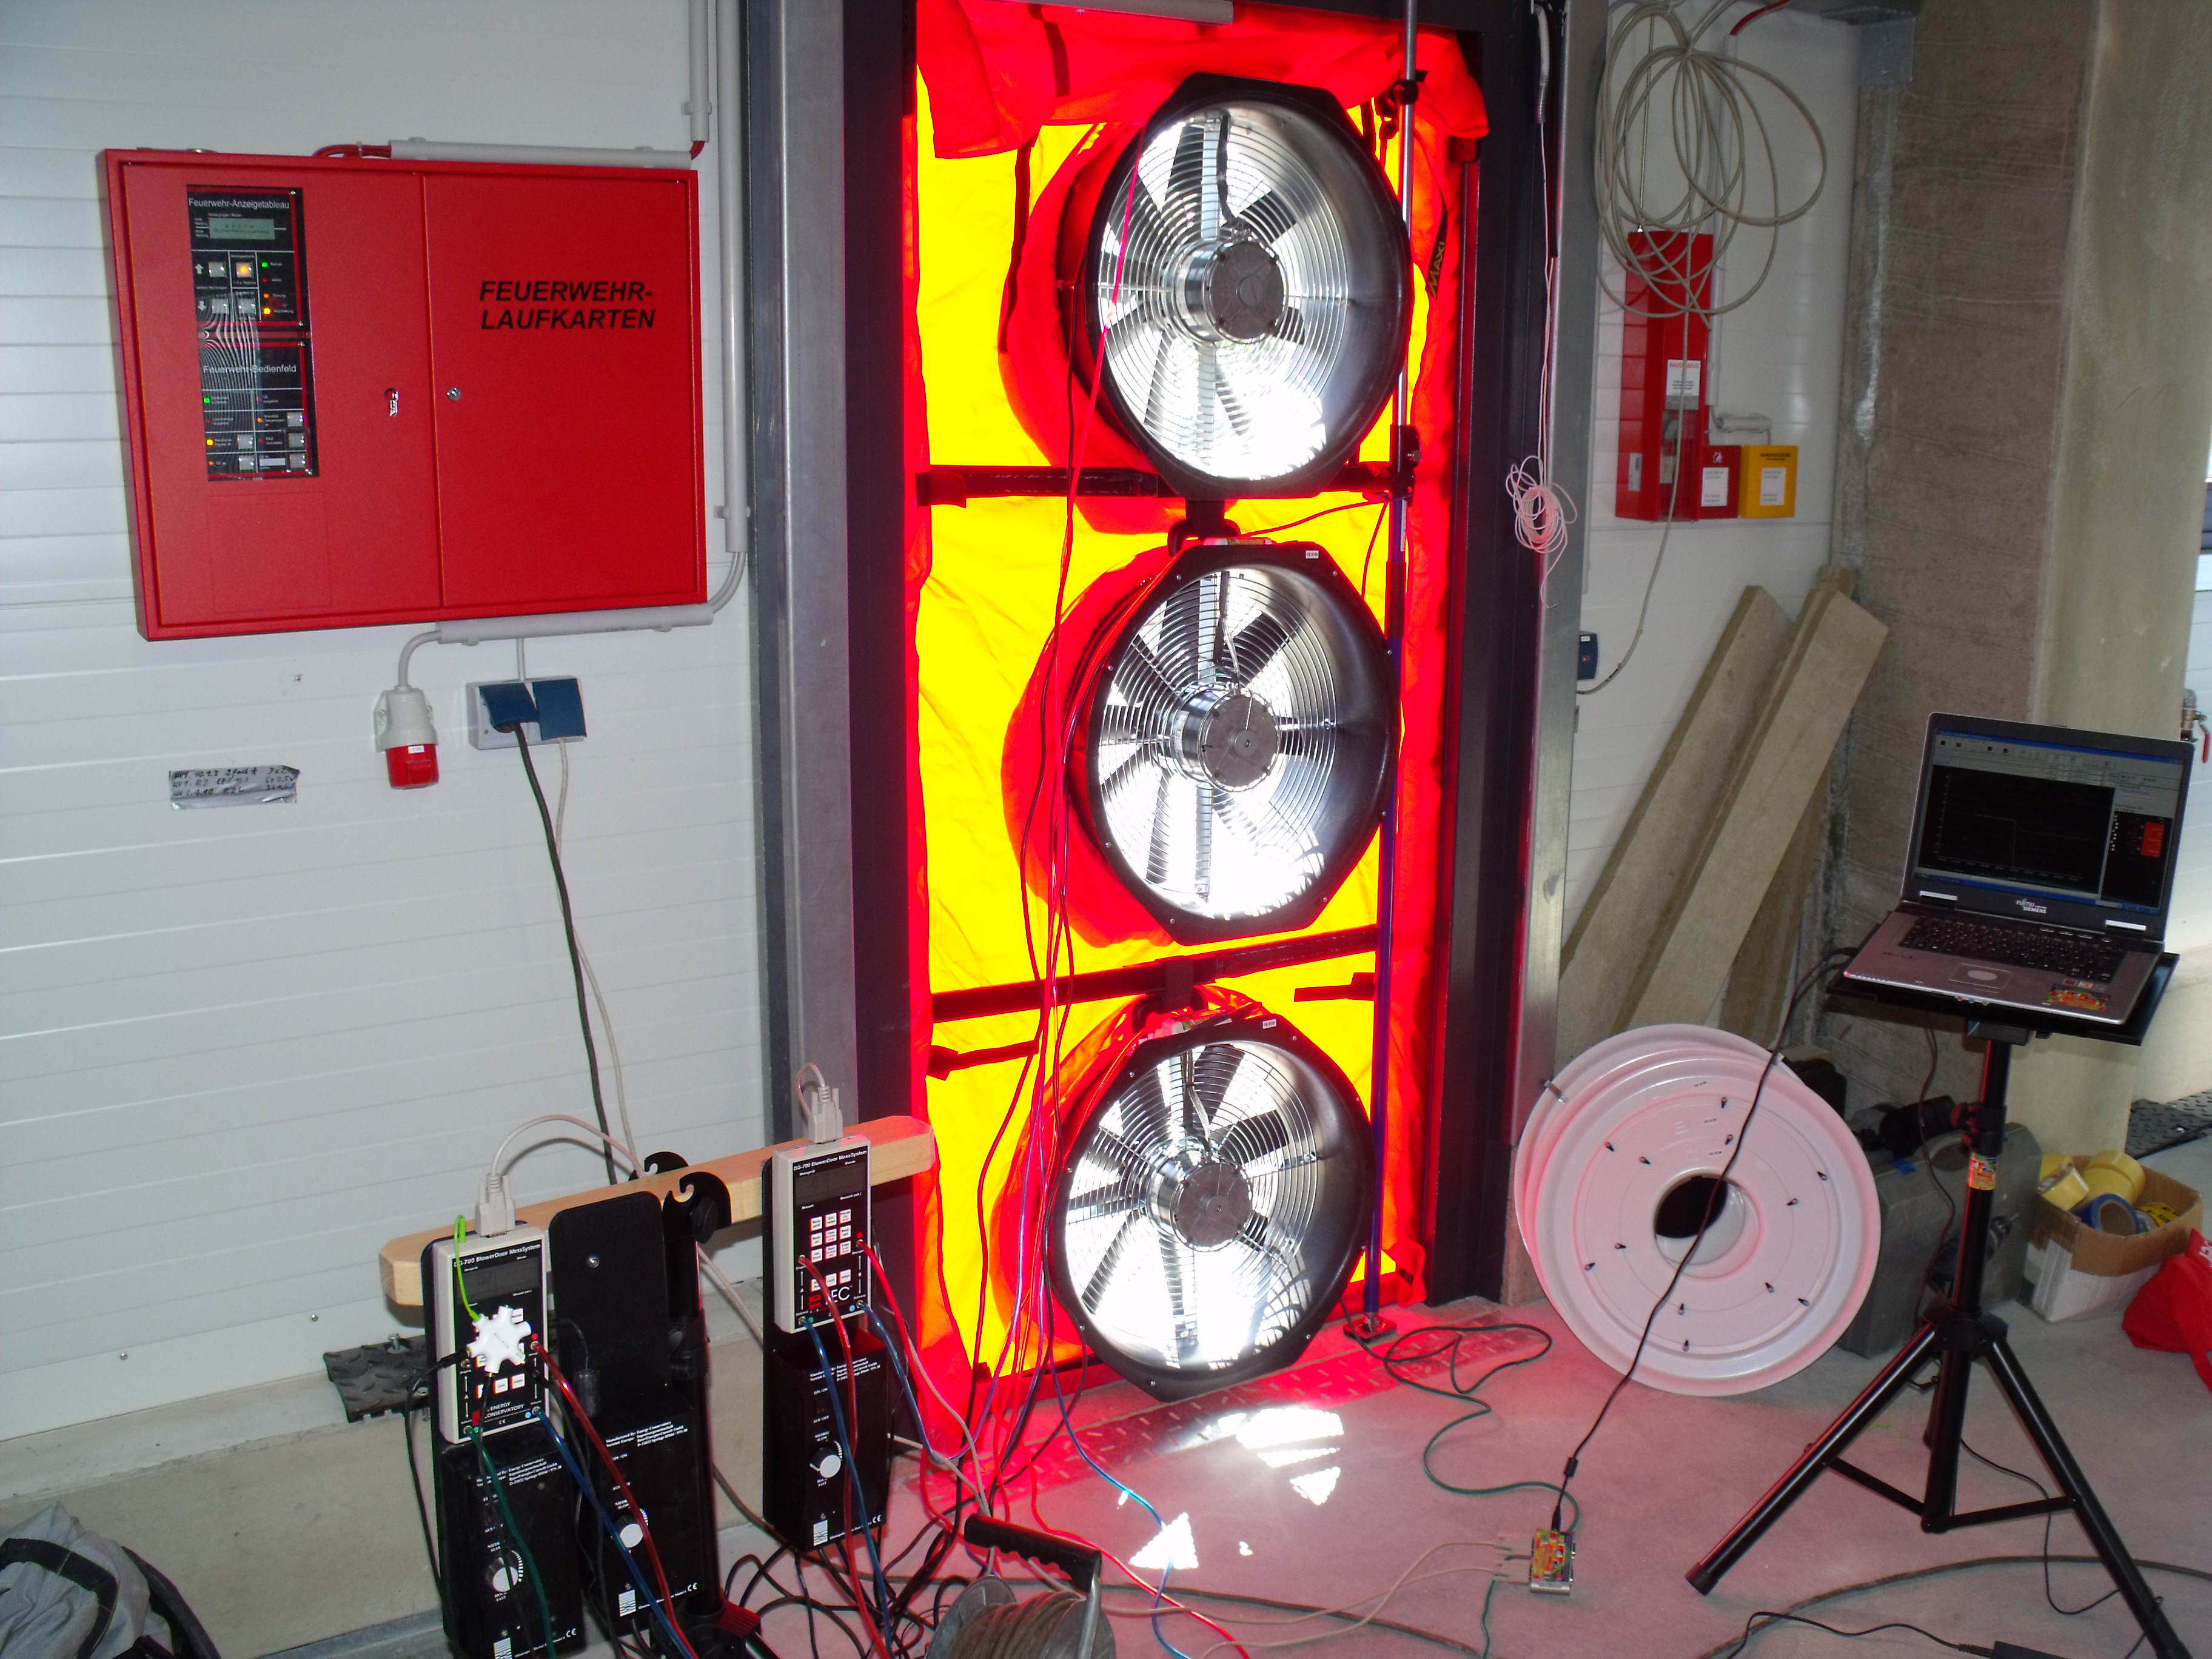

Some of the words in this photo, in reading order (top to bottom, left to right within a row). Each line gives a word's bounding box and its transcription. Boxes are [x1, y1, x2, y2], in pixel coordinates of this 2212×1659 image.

[189, 198, 290, 210] Feuerwehr-Anzeigetableau
[479, 281, 653, 301] FEUERWEHR-
[481, 309, 655, 329] LAUFKARTEN
[203, 364, 297, 374] Feuerwehr-Bedienfeld
[484, 1404, 525, 1419] ONSERVATORY
[490, 1401, 512, 1411] ENERGY
[565, 1627, 577, 1638] CE
